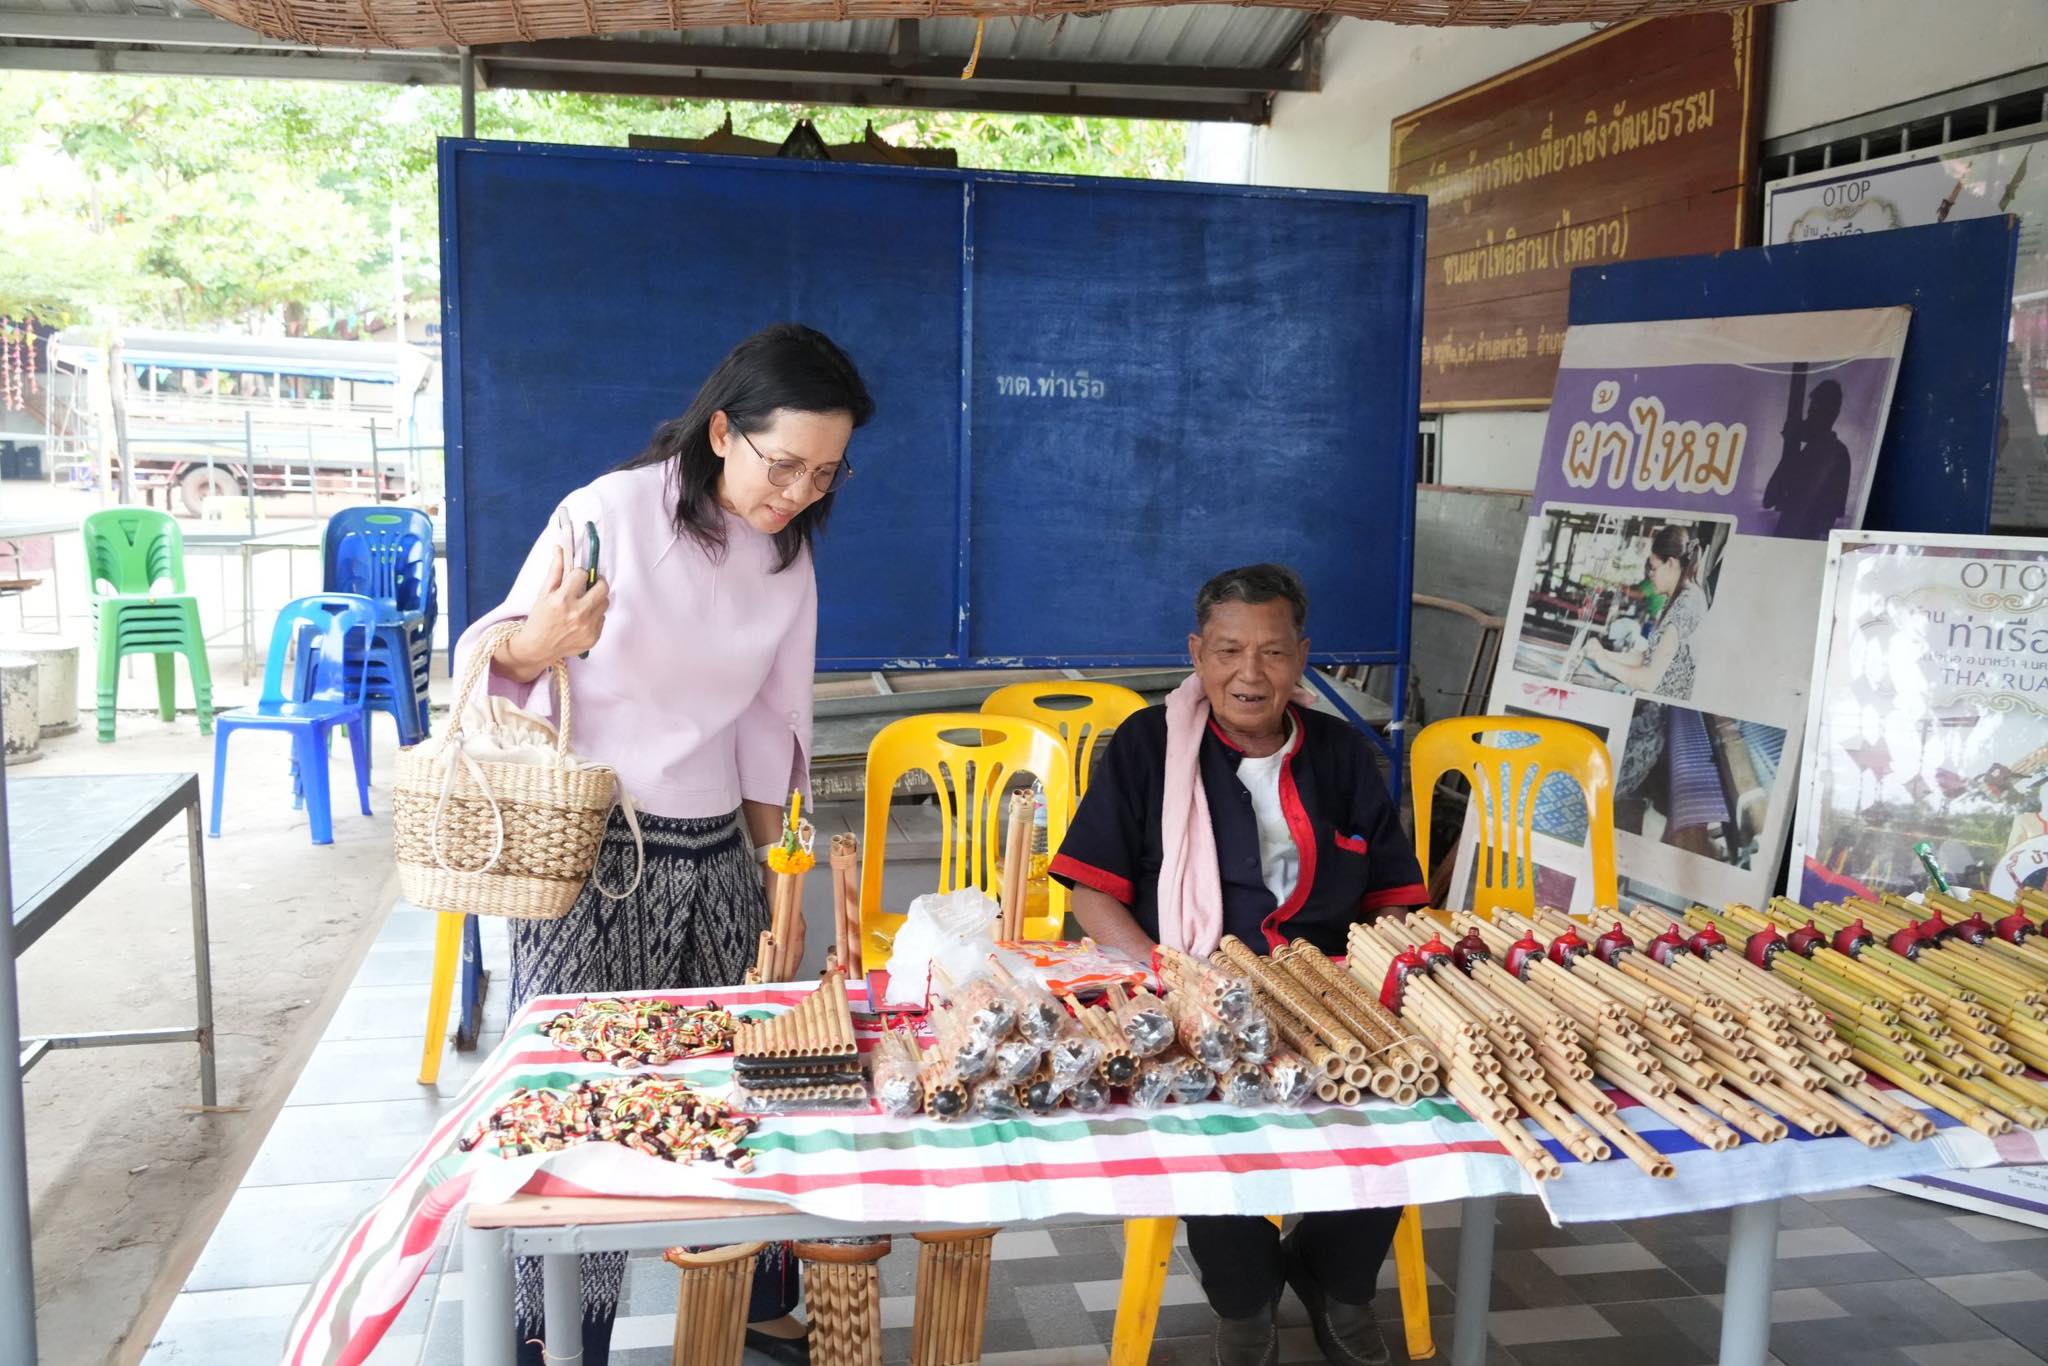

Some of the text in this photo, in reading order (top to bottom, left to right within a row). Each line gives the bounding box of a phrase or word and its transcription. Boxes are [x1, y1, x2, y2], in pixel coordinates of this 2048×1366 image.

[1822, 179, 1871, 208] OTOP
[1552, 206, 1630, 269] (ไทลาว)
[1566, 384, 1742, 489] ผ้าไหม
[1948, 615, 2048, 654] ท่าเรือ
